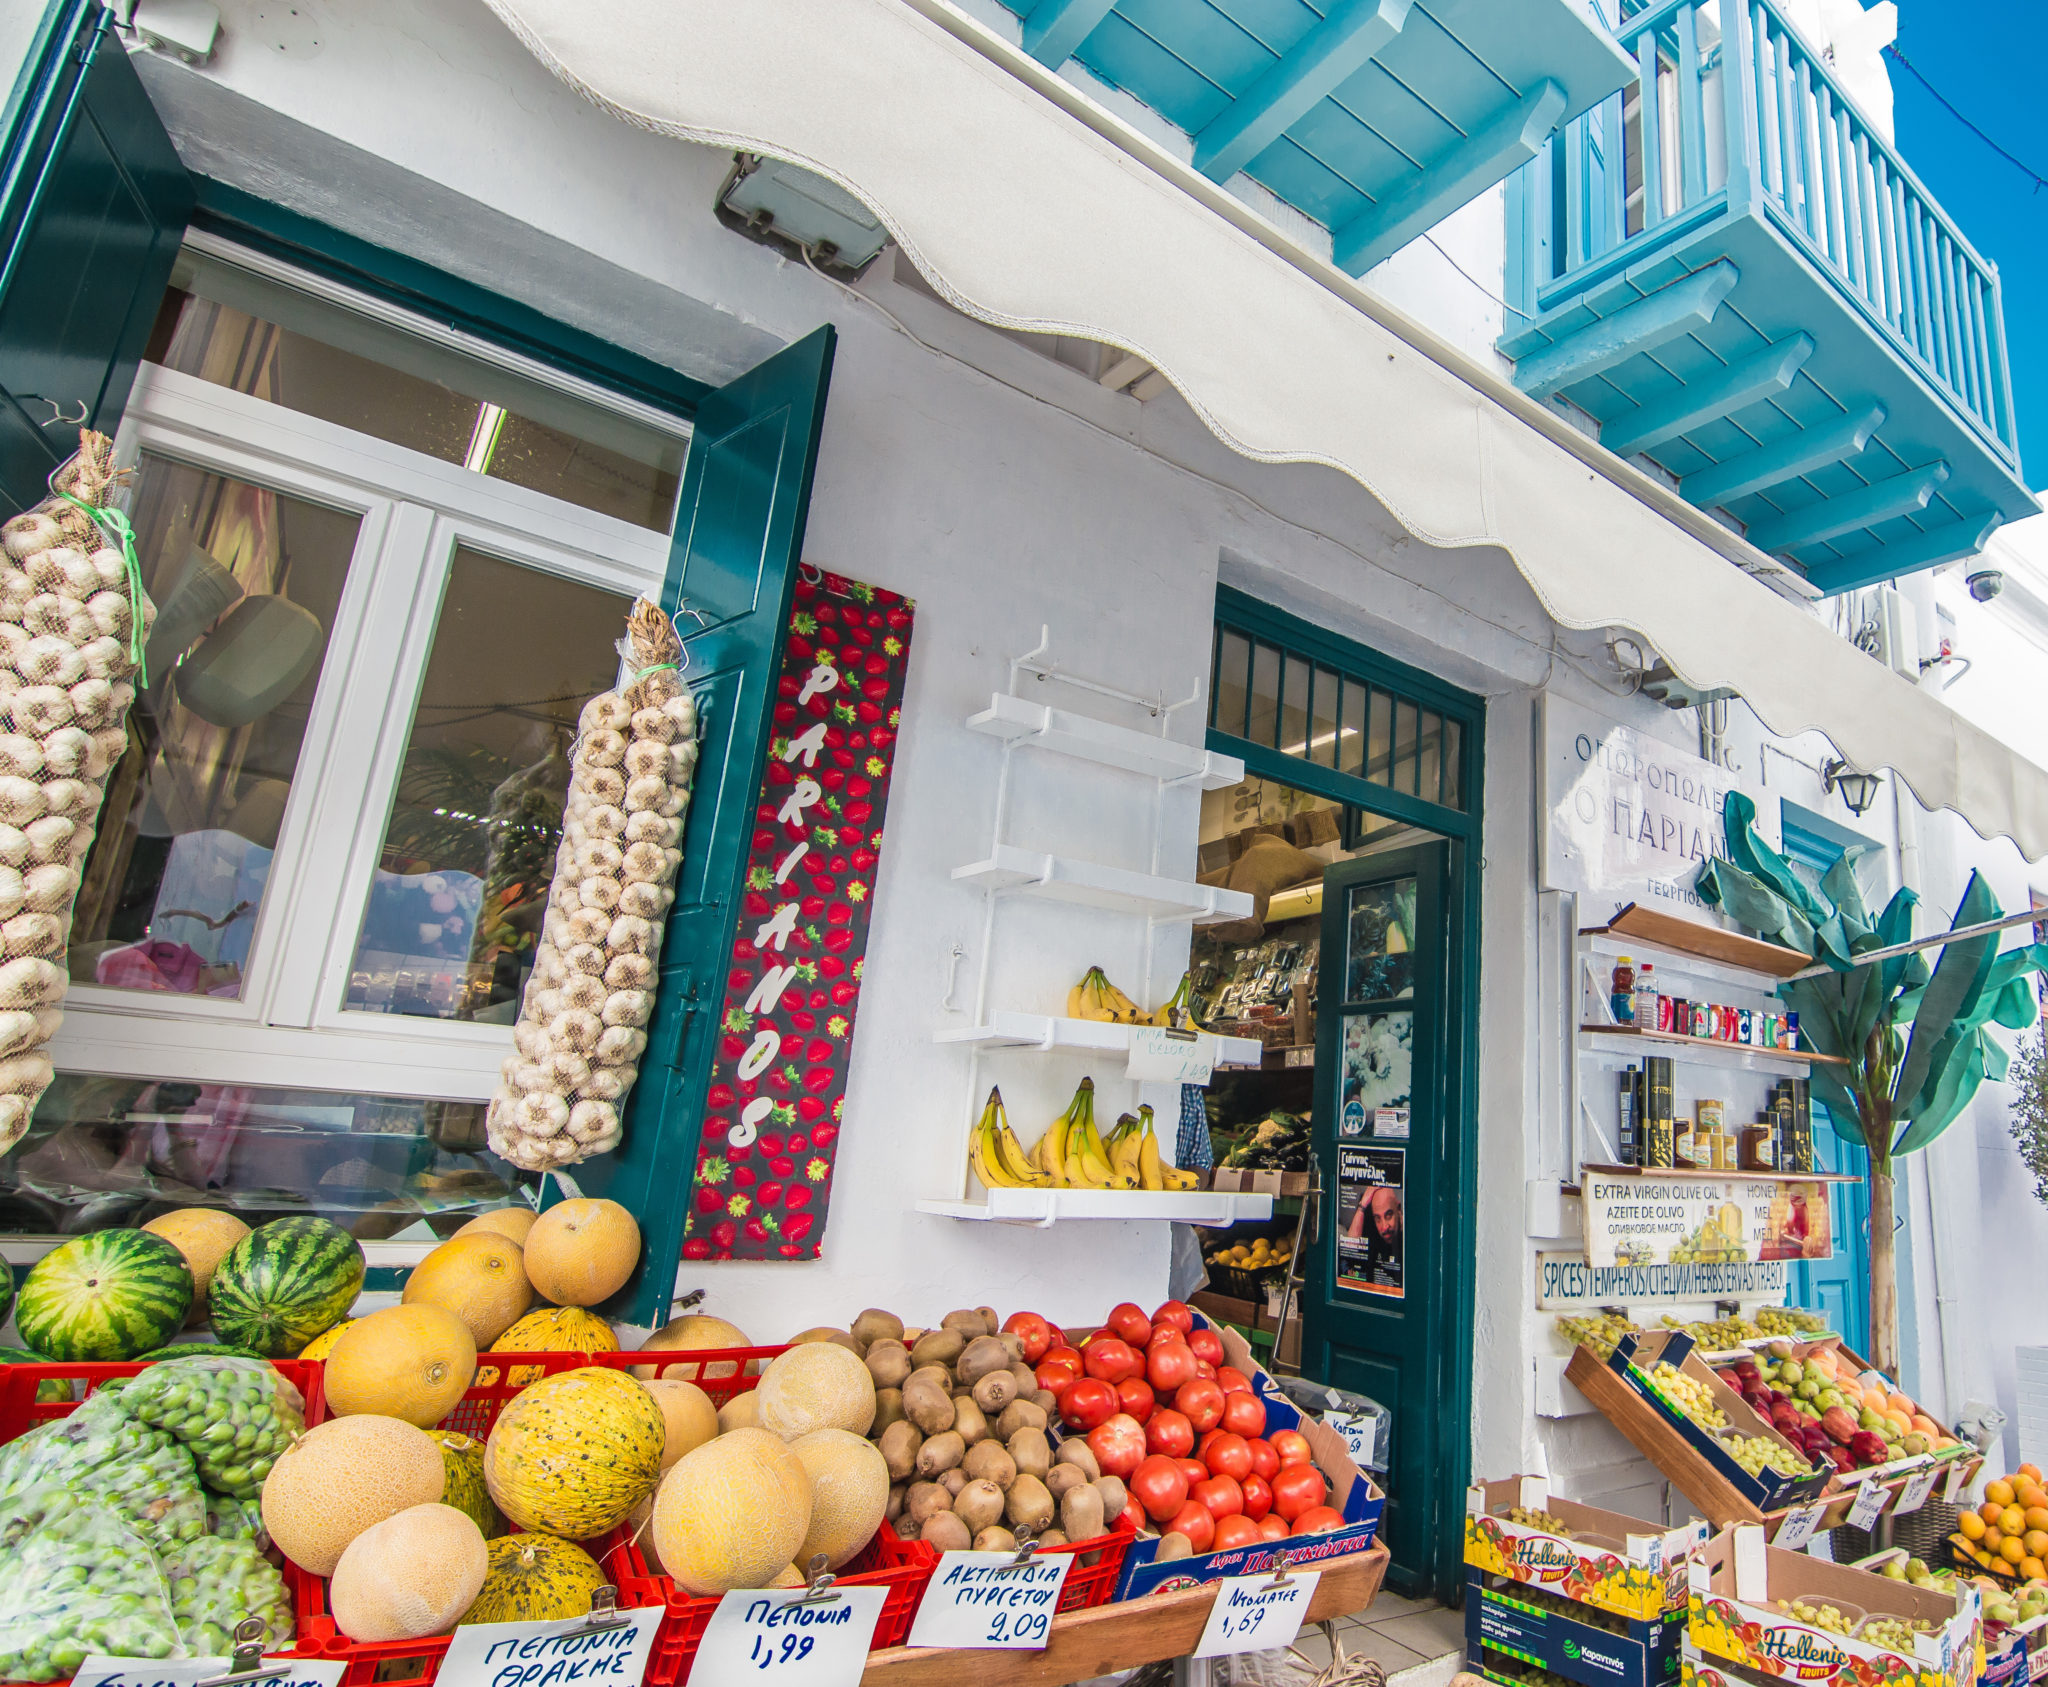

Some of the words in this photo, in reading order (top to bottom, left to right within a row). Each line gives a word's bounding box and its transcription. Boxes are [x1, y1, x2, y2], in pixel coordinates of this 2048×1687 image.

[728, 664, 839, 1148] PARIANOS
[1594, 1184, 1631, 1200] EXTRA
[1633, 1184, 1670, 1200] VIRGIN
[1672, 1184, 1701, 1200] OLIVE
[1703, 1184, 1720, 1200] OIL
[1746, 1184, 1778, 1199] HONEY
[1607, 1206, 1640, 1219] AZEITE
[1641, 1206, 1655, 1219] DE
[1657, 1206, 1684, 1218] OLIVO
[1754, 1206, 1773, 1220] MEL
[1608, 1223, 1656, 1235] ОЛИВКОВОЕ
[1658, 1222, 1686, 1234] МАСЛО
[1753, 1226, 1773, 1241] МЕД
[1238, 1534, 1369, 1576] Παακώστα
[1517, 1539, 1579, 1567] Hellenic
[1541, 1570, 1566, 1582] FRUITS
[954, 1587, 1054, 1608] ΠΥΡΓΕΤΟΥ
[745, 1599, 852, 1628] ΠΕΠΟΝΙΑ
[483, 1627, 639, 1665] ΠΕΠΟΝΙΑ
[750, 1633, 815, 1669] 1,99
[1762, 1627, 1851, 1667] Hellenic
[1581, 1645, 1625, 1671] Καραντινός
[1799, 1666, 1831, 1679] FRUITS
